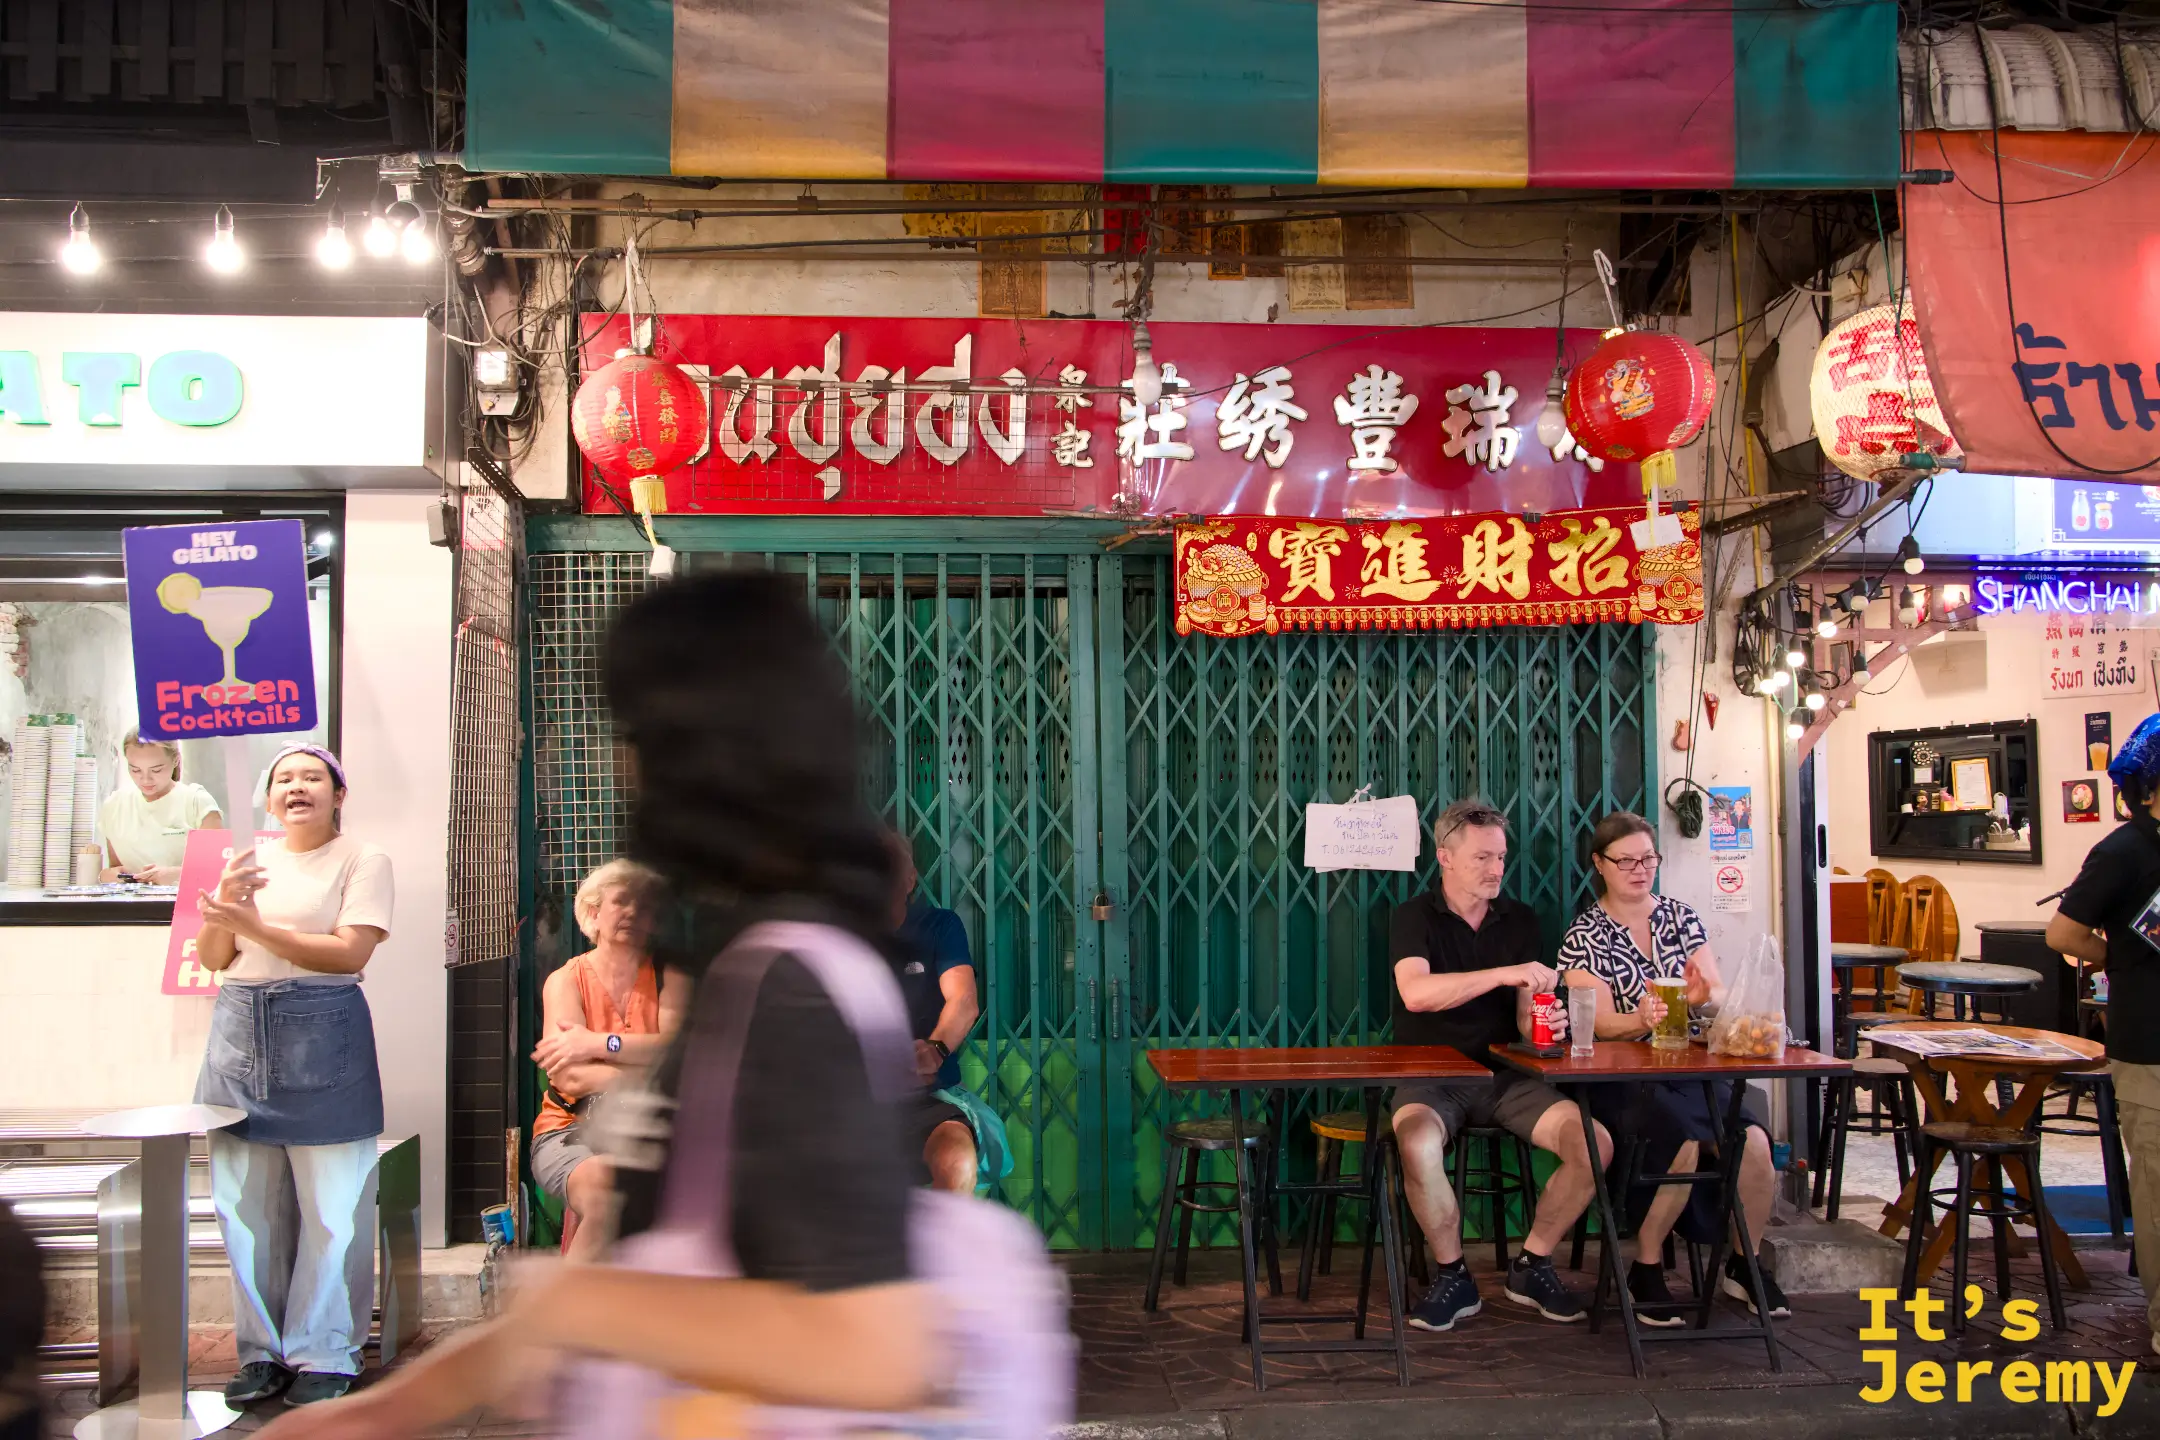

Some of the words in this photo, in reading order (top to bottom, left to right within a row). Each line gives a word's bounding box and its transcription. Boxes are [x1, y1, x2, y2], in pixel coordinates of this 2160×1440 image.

[191, 530, 237, 548] HEY
[172, 544, 258, 565] GELATO
[156, 679, 299, 711] Frozen
[159, 703, 301, 732] Cocktails
